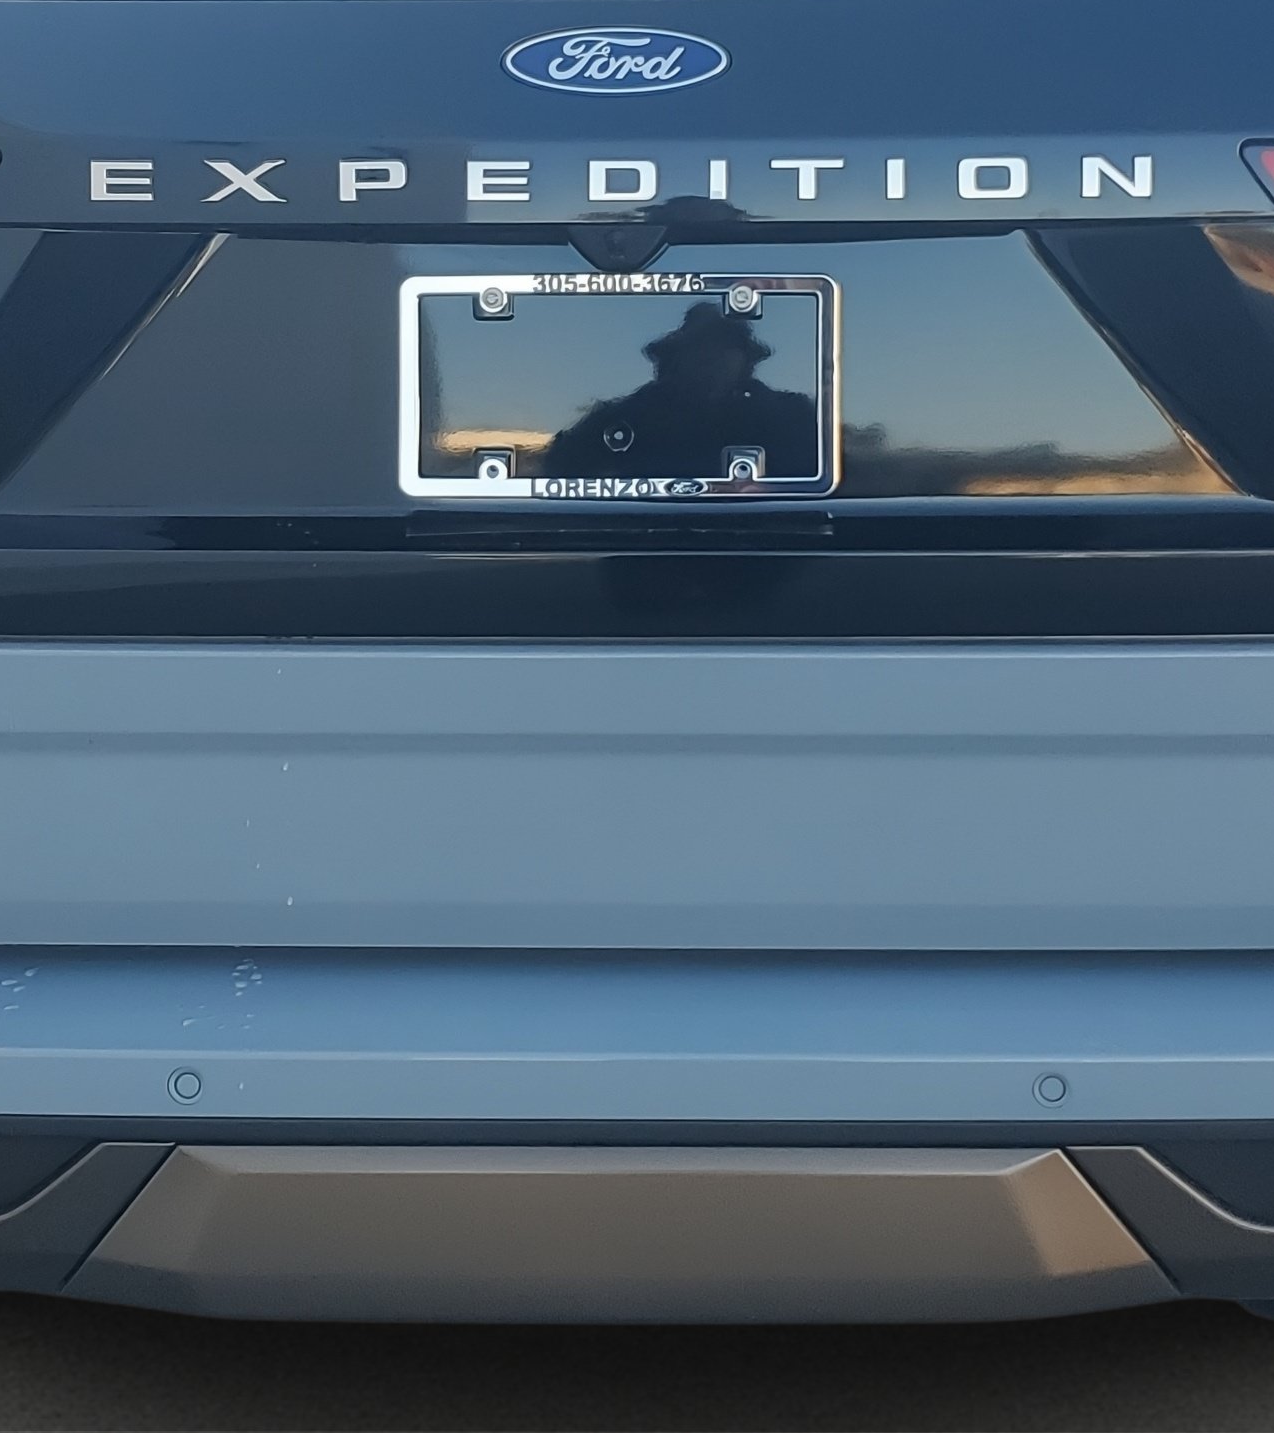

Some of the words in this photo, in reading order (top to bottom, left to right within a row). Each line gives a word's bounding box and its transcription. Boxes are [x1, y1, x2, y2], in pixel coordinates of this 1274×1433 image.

[548, 36, 686, 81] Ford
[89, 155, 1154, 203] EXPEDITION
[532, 272, 705, 293] 305-600-3676
[530, 478, 652, 497] LORENZO
[670, 481, 701, 495] Ford
